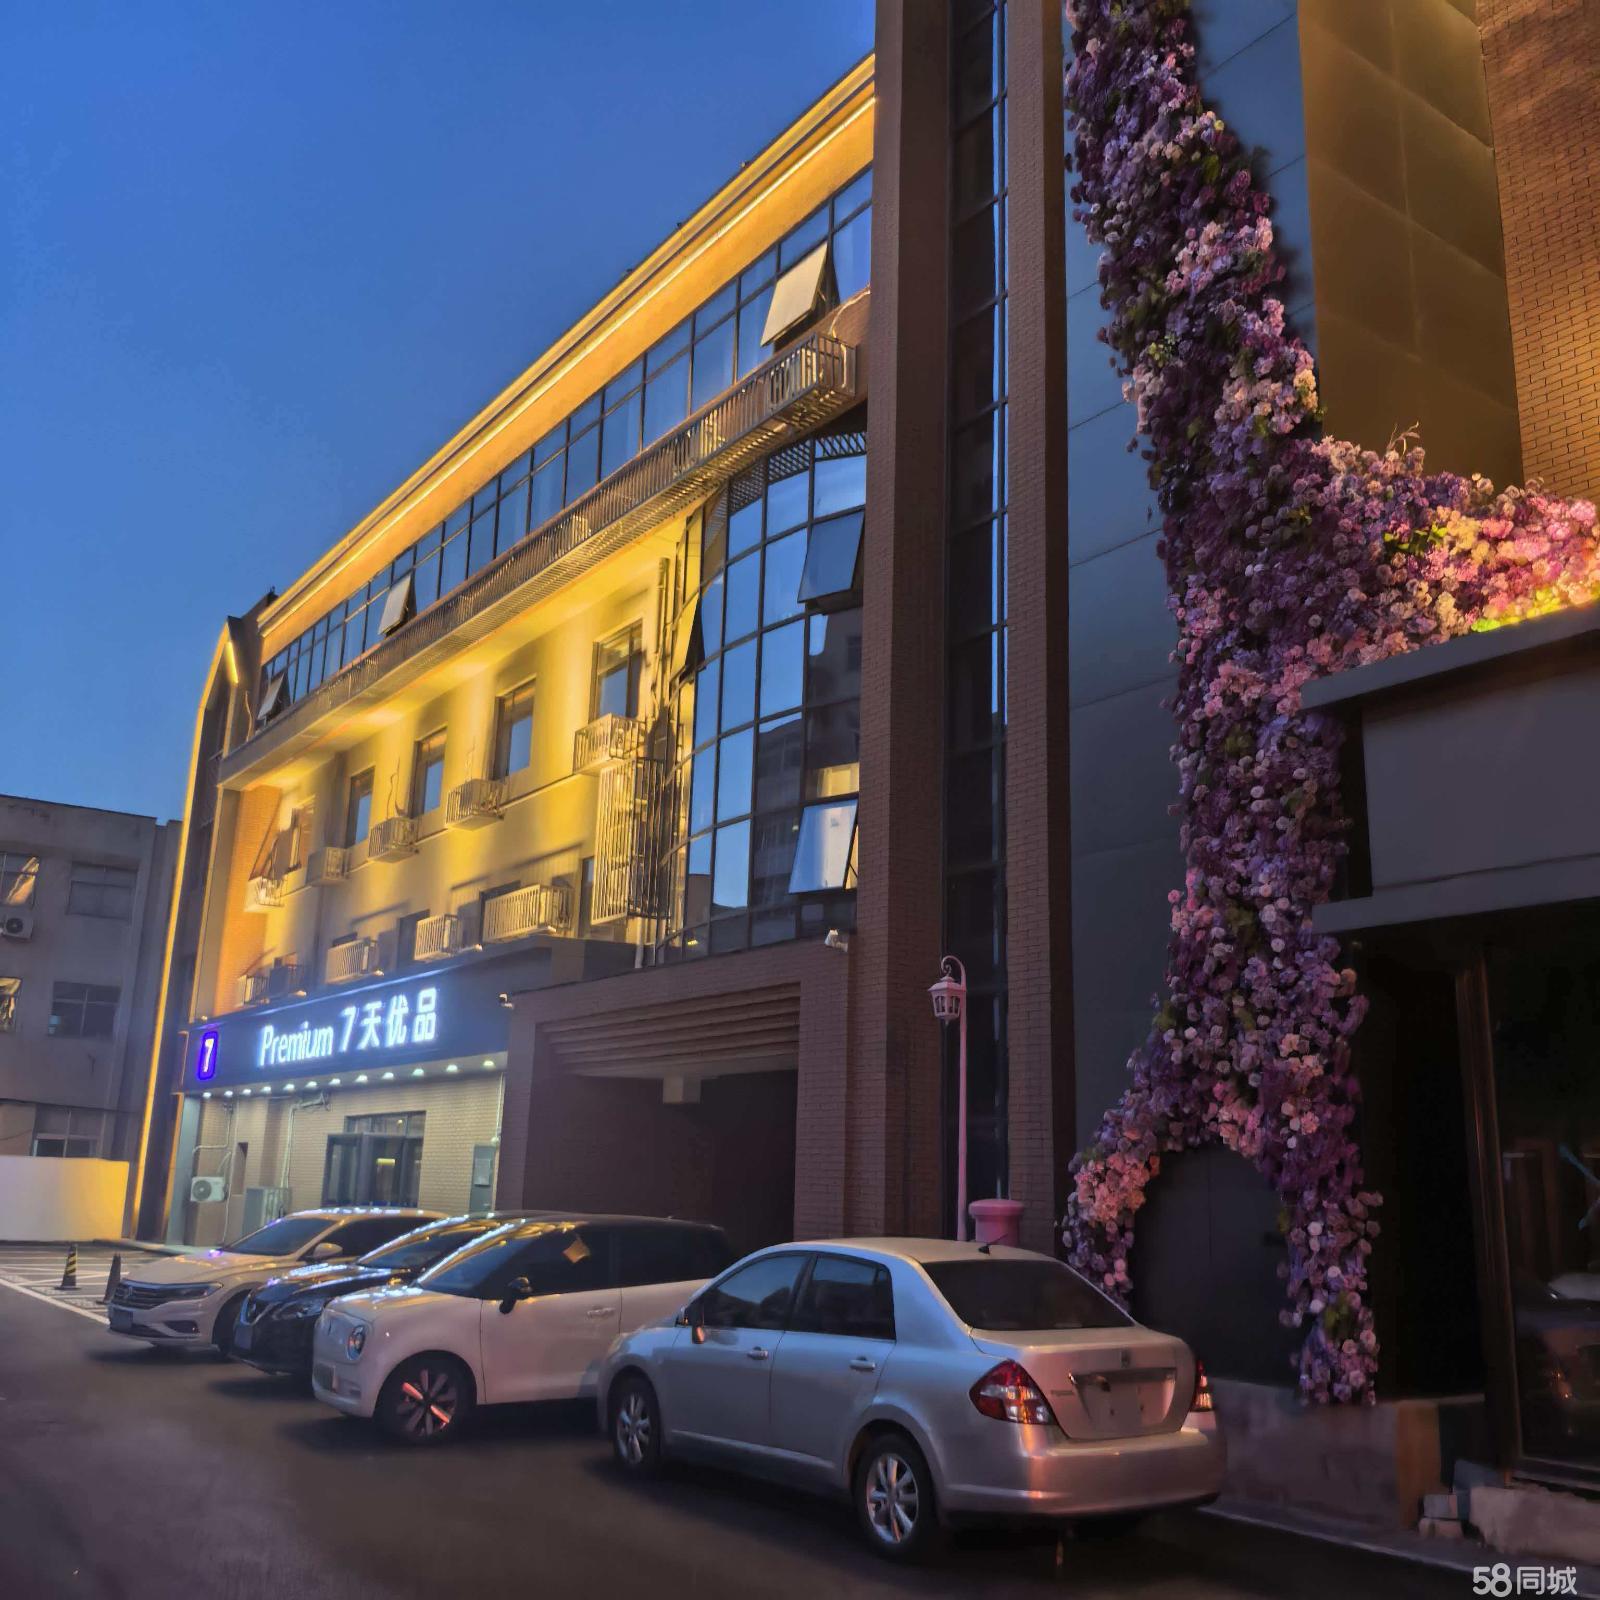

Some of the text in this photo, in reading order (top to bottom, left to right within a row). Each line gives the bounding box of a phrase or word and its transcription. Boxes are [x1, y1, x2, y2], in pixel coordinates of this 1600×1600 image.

[202, 1037, 215, 1073] 7
[259, 987, 438, 1066] Premium 7天优品
